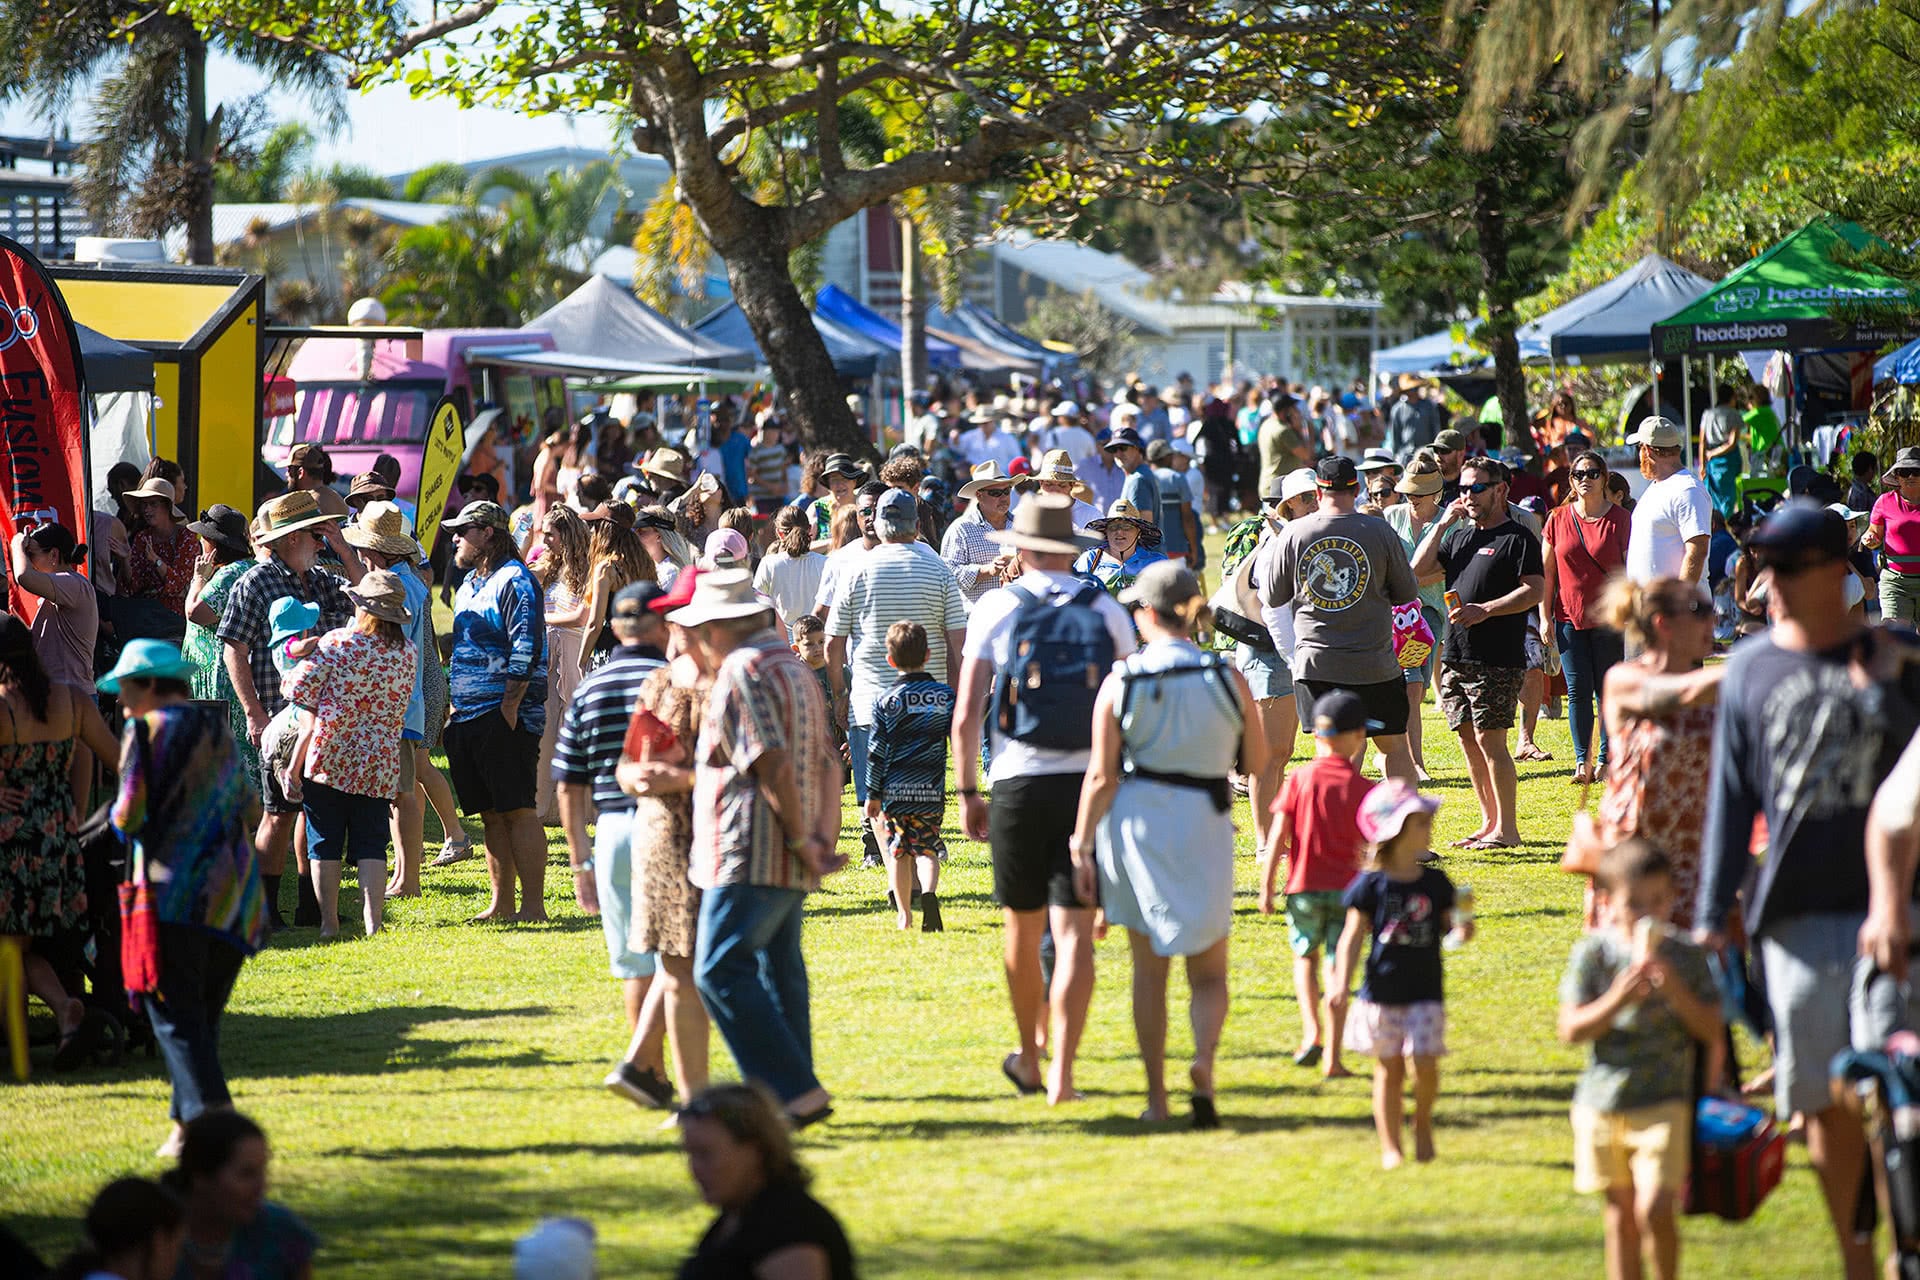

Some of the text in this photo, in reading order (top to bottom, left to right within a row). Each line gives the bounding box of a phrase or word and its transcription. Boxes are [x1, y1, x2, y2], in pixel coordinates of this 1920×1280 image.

[1767, 285, 1909, 301] headspace
[1695, 324, 1788, 342] headspace
[1, 368, 49, 508] Fusion
[1304, 540, 1366, 564] SALTY LIFE
[1313, 574, 1367, 609] DRINKS BOYS
[521, 591, 529, 640] ANGLERS
[906, 690, 948, 706] DGC
